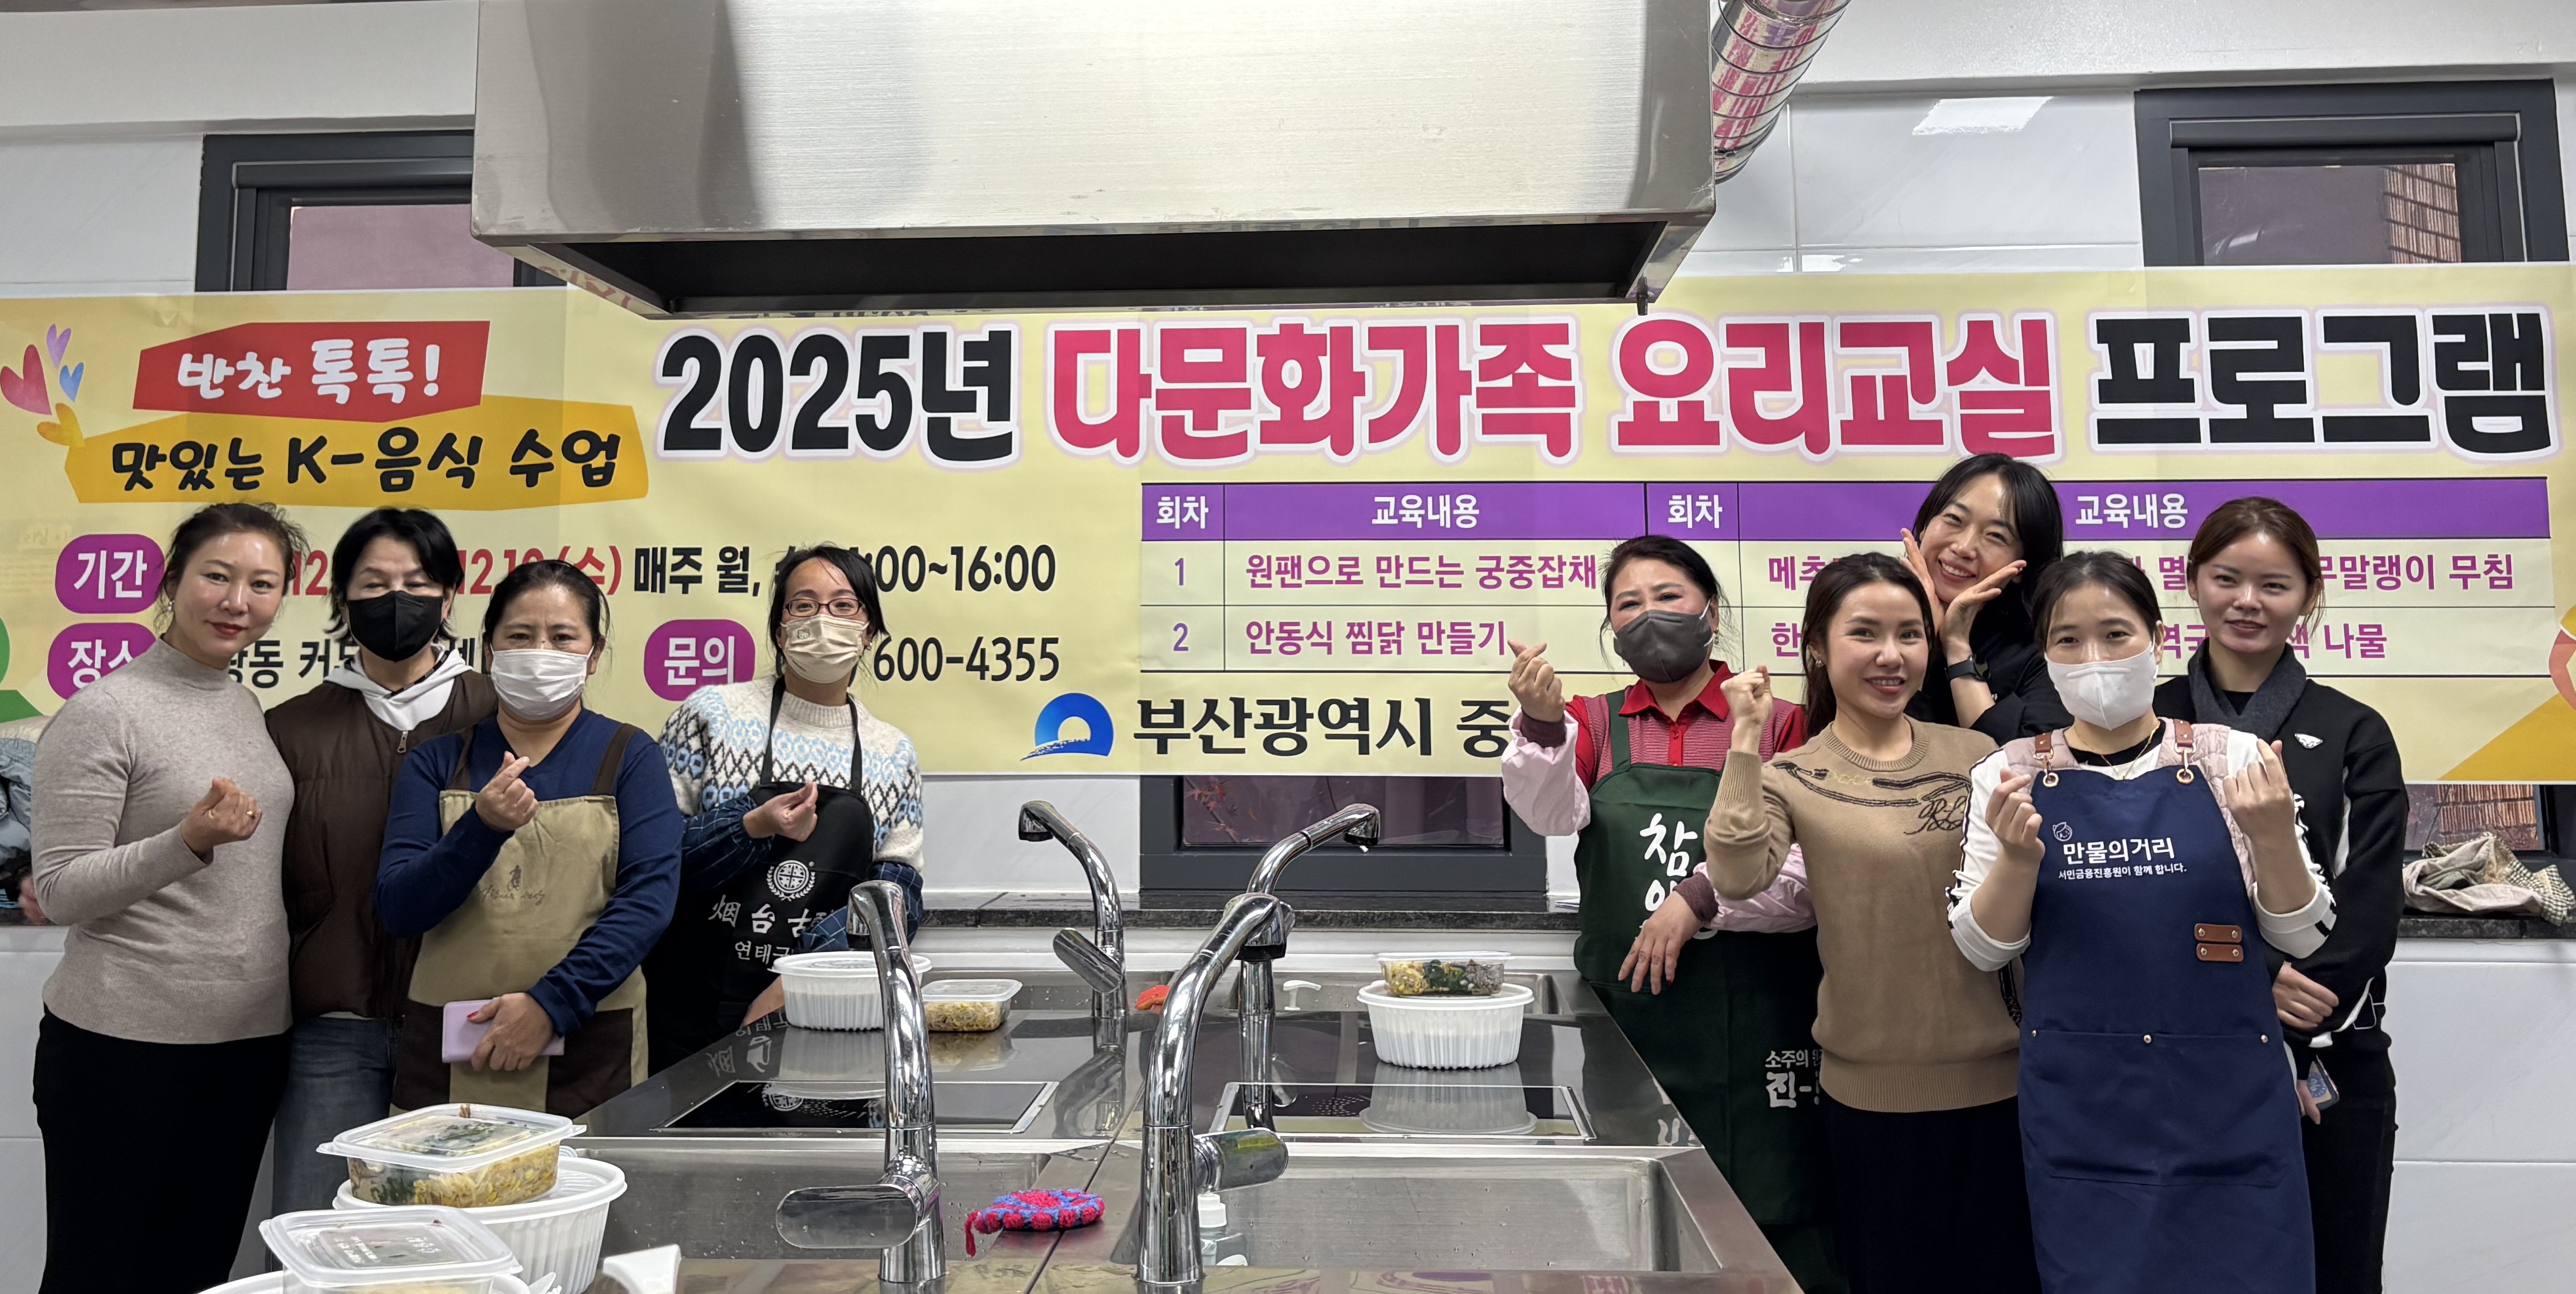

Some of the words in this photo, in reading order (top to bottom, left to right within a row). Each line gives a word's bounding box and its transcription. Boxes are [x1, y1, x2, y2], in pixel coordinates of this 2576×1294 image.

[177, 352, 291, 399] 반찬
[311, 338, 440, 404] 톡톡!
[662, 330, 1013, 462] 2025년
[1054, 323, 1576, 459] 다문화가족
[1617, 319, 2055, 457] 요리교실
[2096, 313, 2551, 454] 프로그램
[112, 437, 265, 492] 맛있는
[287, 427, 483, 493] K-음식
[509, 428, 621, 488] 수업
[1156, 495, 1209, 529] 회차
[1371, 494, 1480, 528] 교육내용
[1668, 494, 1723, 528] 회차
[2075, 493, 2188, 528] 교육내용
[73, 550, 148, 599] 기간
[634, 546, 702, 594] 매주
[716, 546, 760, 597] 월,
[1174, 560, 1184, 585] 1
[1247, 555, 1363, 588] 원팬으로
[1376, 556, 1464, 588] 만드는
[1476, 555, 1597, 589] 궁중잡채
[1769, 556, 1840, 591] 메추
[2450, 554, 2513, 590] 무침
[1173, 623, 1188, 651] 2
[1246, 621, 1332, 655] 안동식
[1346, 621, 1405, 655] 찜닭
[1417, 621, 1504, 655] 만들기
[2324, 623, 2387, 659] 나물
[664, 636, 735, 686] 문의
[1133, 696, 1432, 757] 부산광역시
[1639, 813, 1699, 877] 참
[2063, 837, 2176, 865] 만물의거리
[2058, 866, 2131, 880] 서민금융진흥원이
[2132, 865, 2153, 877] 함께
[2154, 863, 2187, 875] 합니다.
[1764, 1049, 1809, 1069] 소주의
